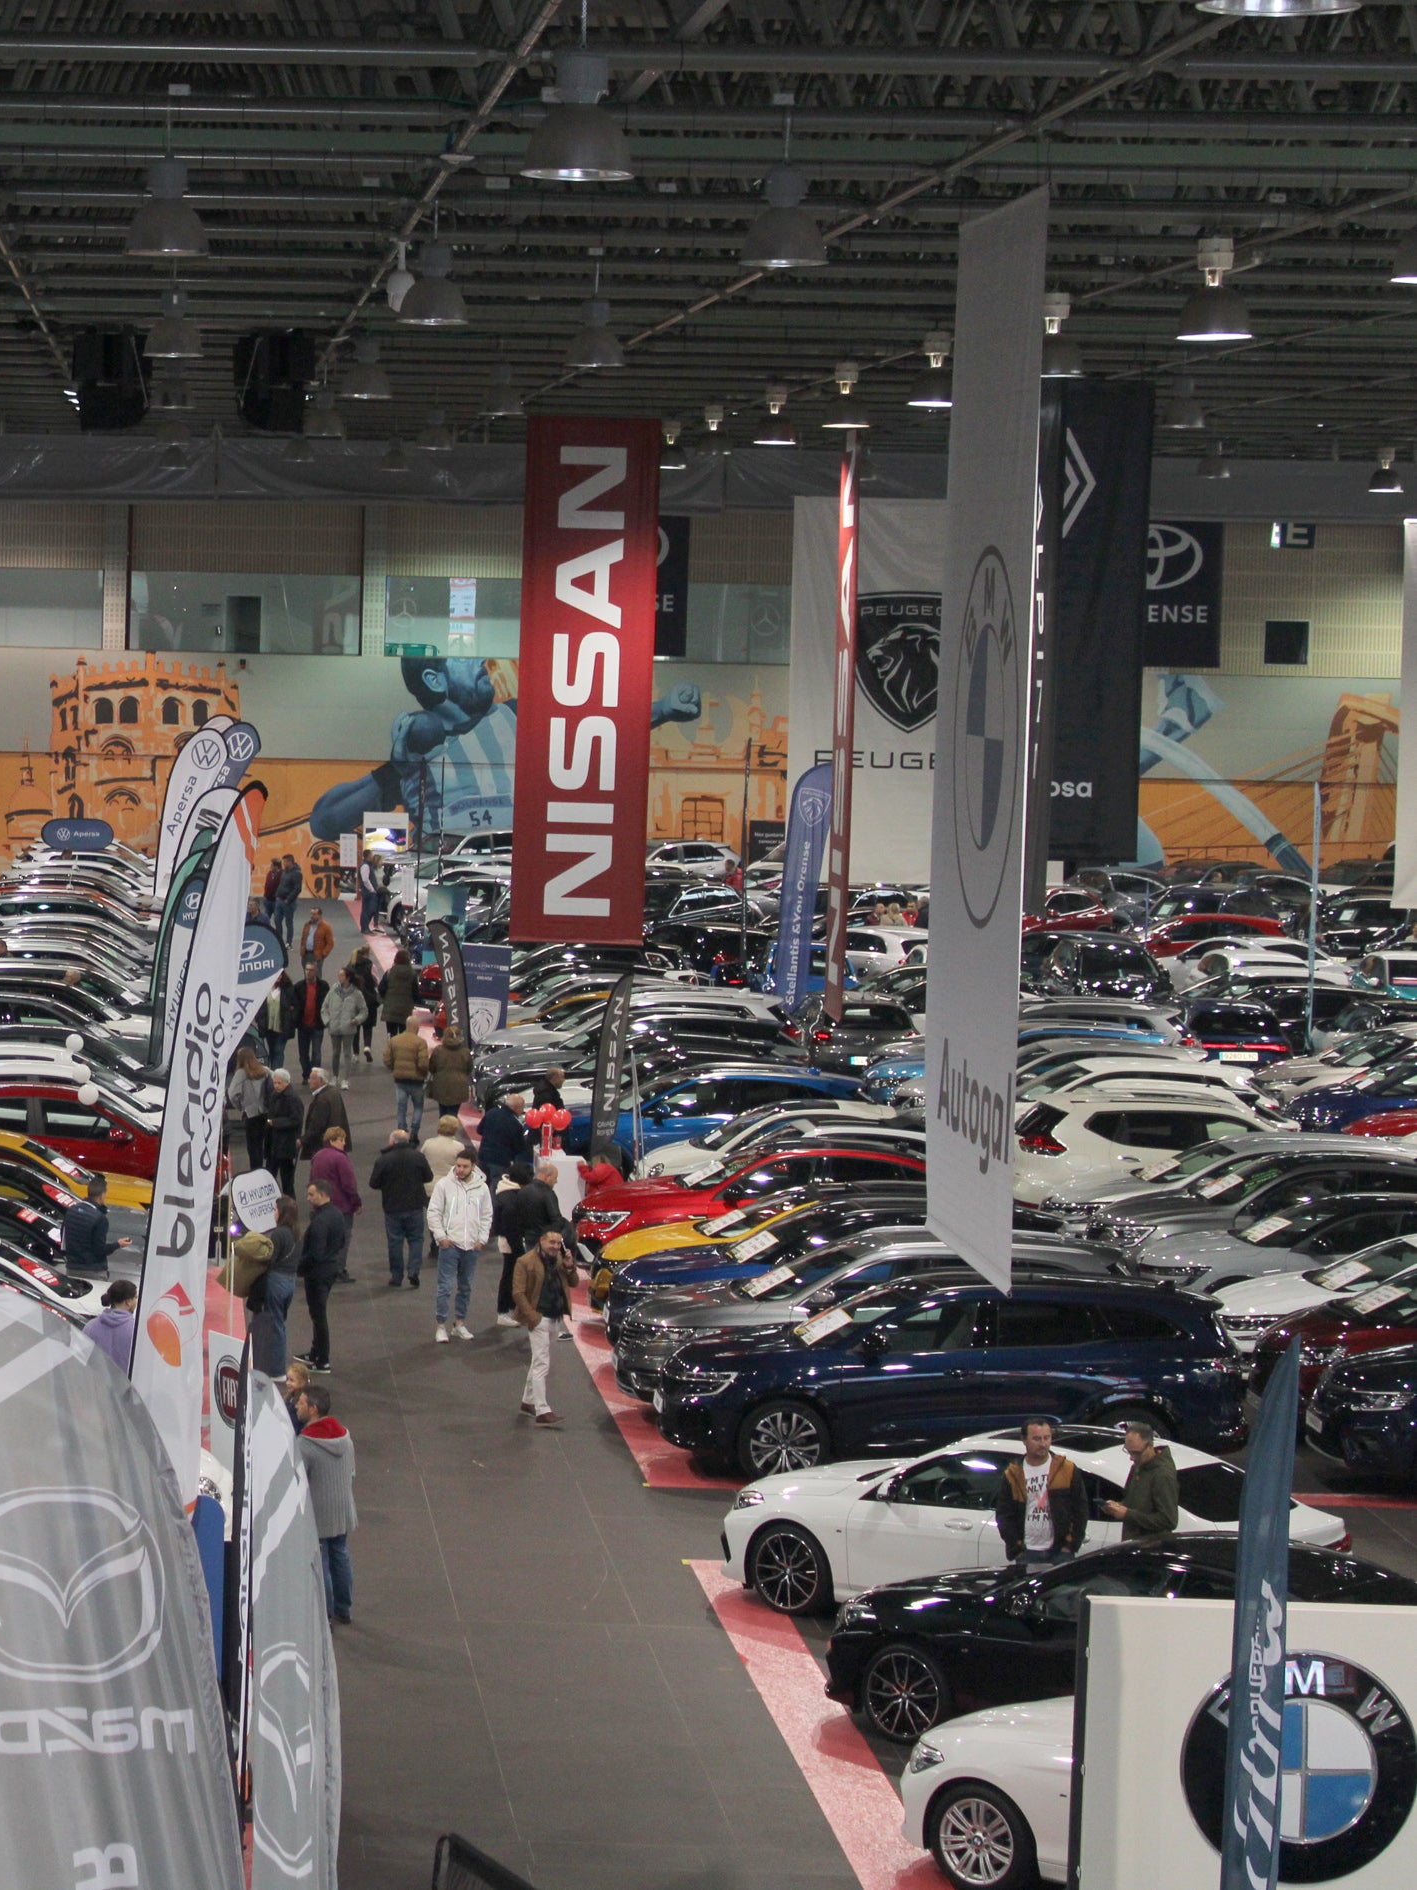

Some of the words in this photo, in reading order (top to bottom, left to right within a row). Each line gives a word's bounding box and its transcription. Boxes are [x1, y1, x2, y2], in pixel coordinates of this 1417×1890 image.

[543, 445, 628, 917] NISSAN
[166, 776, 198, 837] Apersa
[469, 809, 493, 827] 54
[785, 937, 800, 1005] Stellantis
[797, 840, 811, 891] Orense
[603, 996, 624, 1112] NISSAN
[937, 1037, 1012, 1175] Autogal
[156, 982, 212, 1258] blendio
[248, 1183, 276, 1201] HYUNDAI
[222, 1376, 239, 1409] FIA
